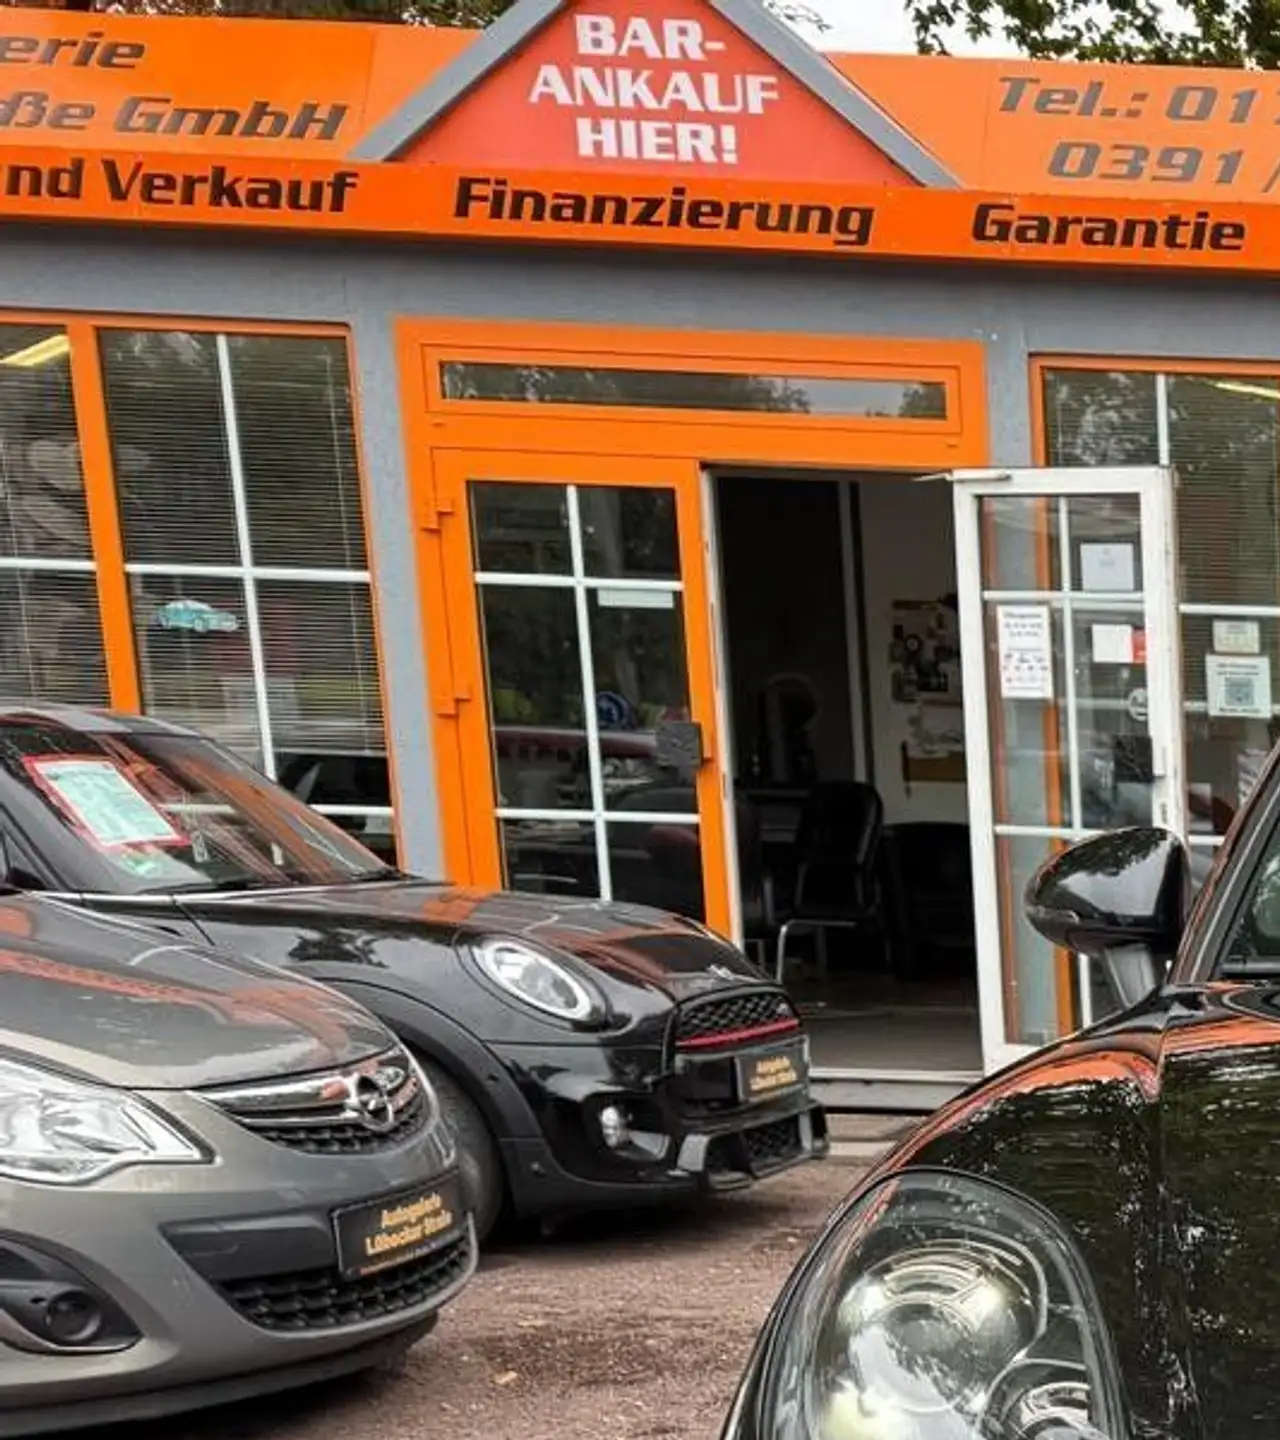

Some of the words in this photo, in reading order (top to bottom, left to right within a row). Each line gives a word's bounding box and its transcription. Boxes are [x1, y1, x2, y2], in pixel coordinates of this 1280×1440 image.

[574, 14, 726, 61] BAR-
[528, 64, 780, 114] ANKAUF
[998, 77, 1149, 118] Tel.:
[114, 96, 349, 140] GmbH
[575, 118, 738, 164] HIER!
[3, 158, 85, 200] nd
[101, 158, 359, 213] Verkauf
[1047, 141, 1243, 184] 0391
[453, 176, 876, 246] Finanzierung
[972, 203, 1246, 251] Garantie
